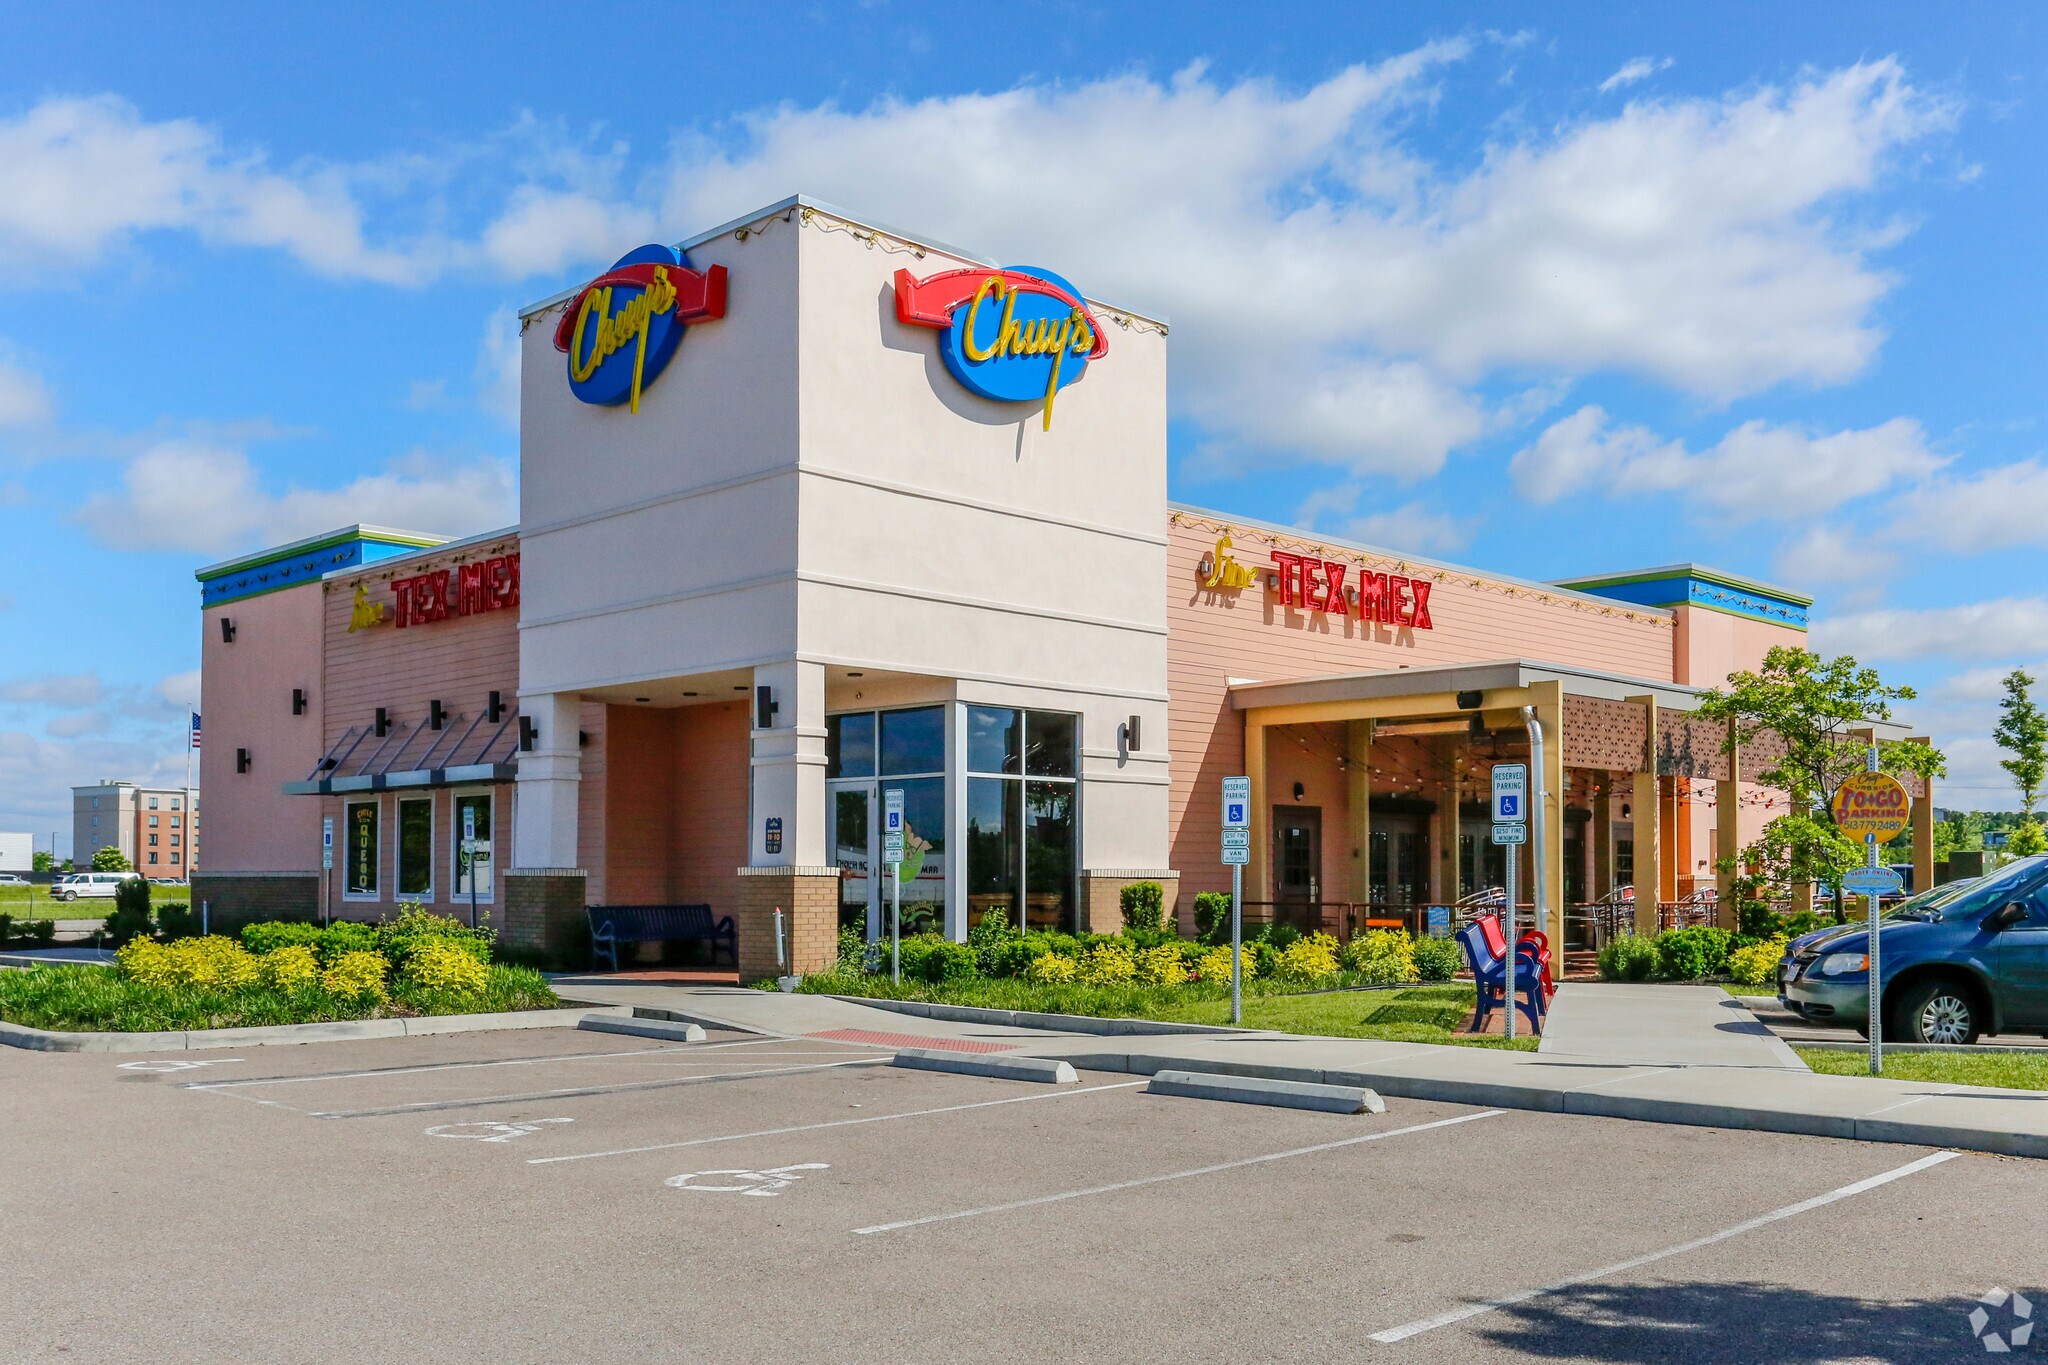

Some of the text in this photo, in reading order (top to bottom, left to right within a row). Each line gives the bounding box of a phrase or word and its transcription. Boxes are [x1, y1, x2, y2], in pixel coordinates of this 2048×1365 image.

[571, 265, 677, 415] Chuy's
[963, 275, 1095, 432] Chuy's
[390, 569, 450, 629] TEX
[458, 553, 520, 617] MEX
[1205, 536, 1434, 630] fine TEX MEX
[1224, 783, 1247, 791] RESERVED
[1495, 772, 1523, 780] RESERVED
[1496, 782, 1522, 790] PARKING
[1836, 808, 1907, 825] PARKING
[359, 824, 369, 888] QUESO
